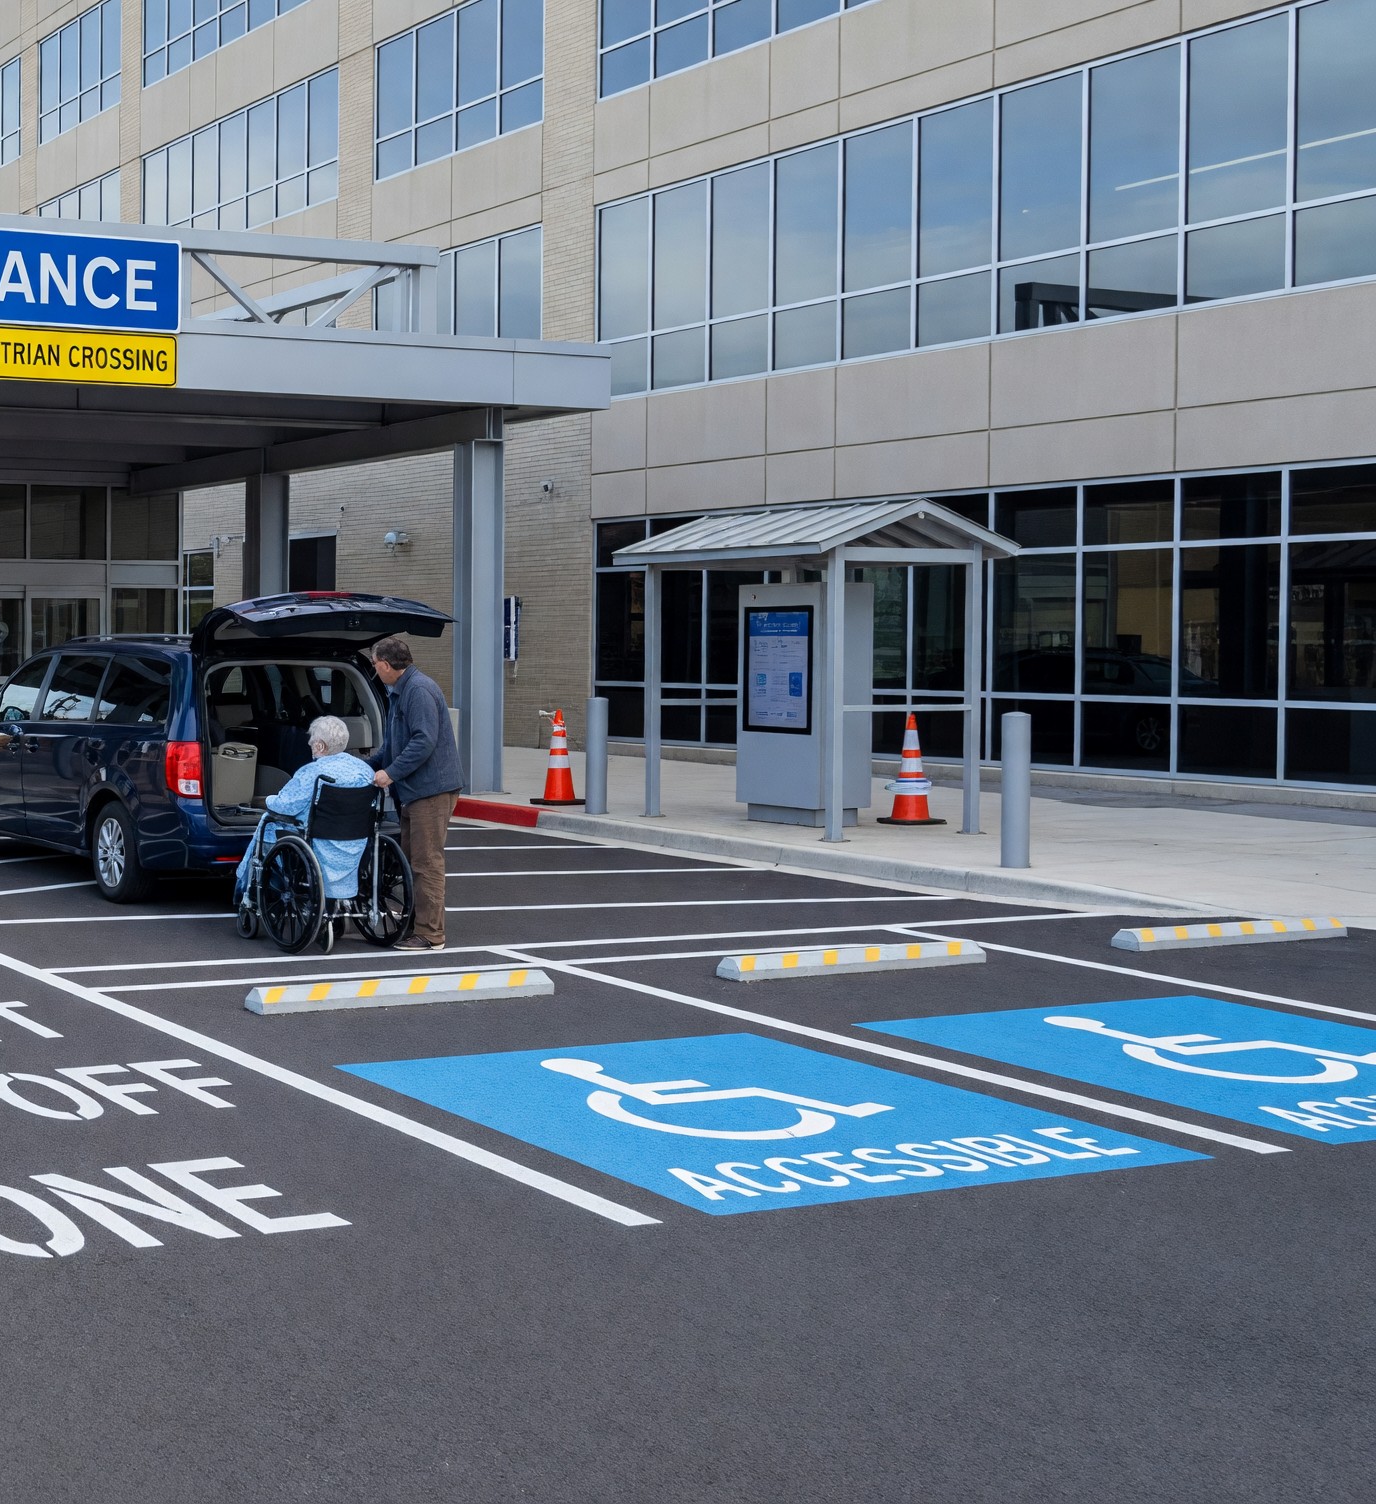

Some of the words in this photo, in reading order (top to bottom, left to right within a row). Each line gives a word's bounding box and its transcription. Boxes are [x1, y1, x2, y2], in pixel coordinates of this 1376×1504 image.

[67, 345, 169, 373] CROSSING
[1257, 1096, 1376, 1132] ACC
[666, 1126, 1142, 1201] ACCESSIBLE
